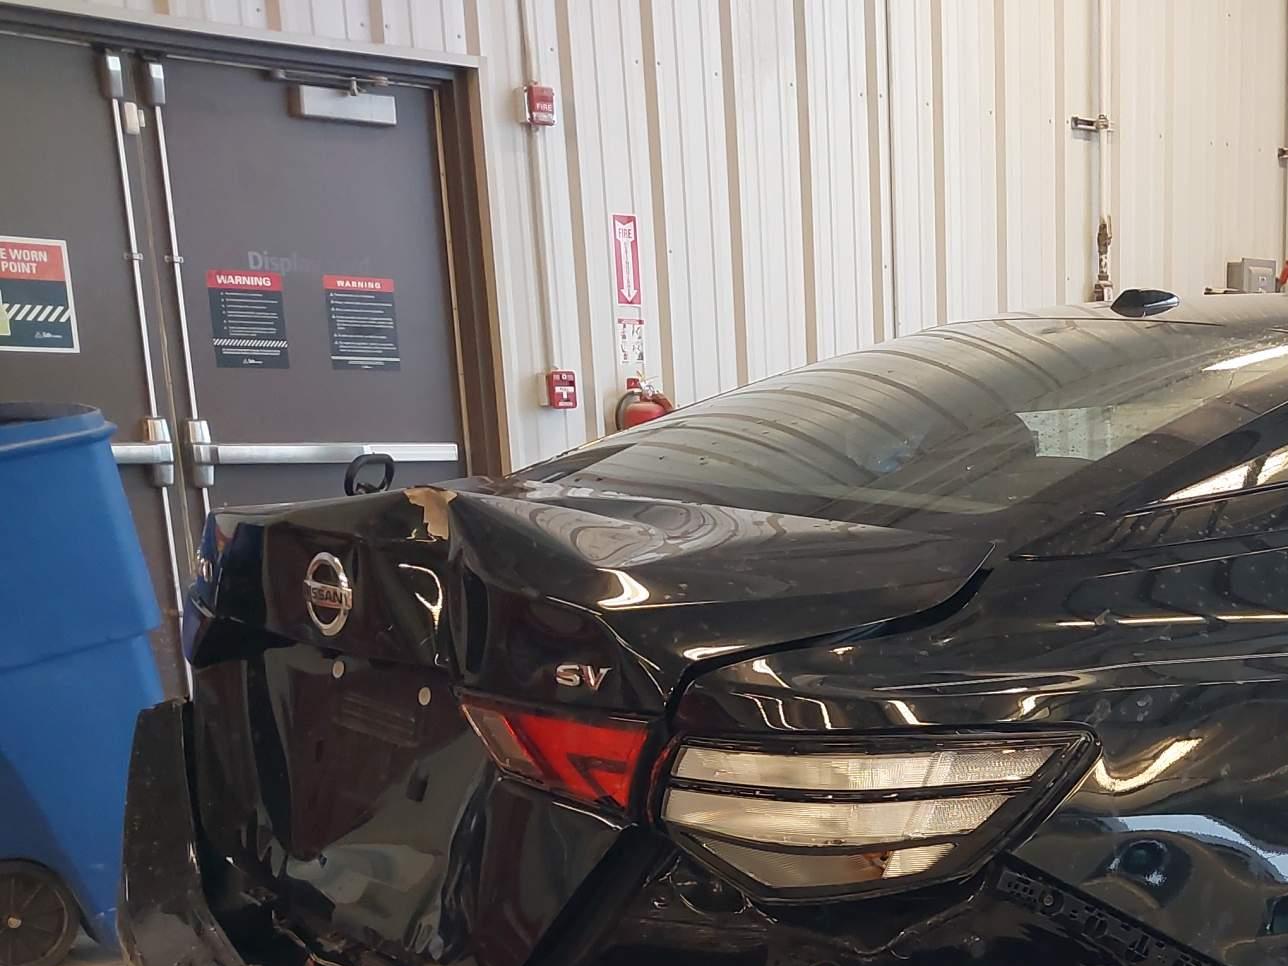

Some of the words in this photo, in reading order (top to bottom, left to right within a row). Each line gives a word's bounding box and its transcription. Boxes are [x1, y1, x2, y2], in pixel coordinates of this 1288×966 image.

[536, 103, 552, 112] FIRE
[618, 228, 632, 239] FIRE
[9, 249, 48, 262] WORN
[1, 261, 37, 274] POINT
[216, 274, 272, 287] WARNING
[336, 280, 382, 290] WARNING
[556, 664, 613, 691] SV
